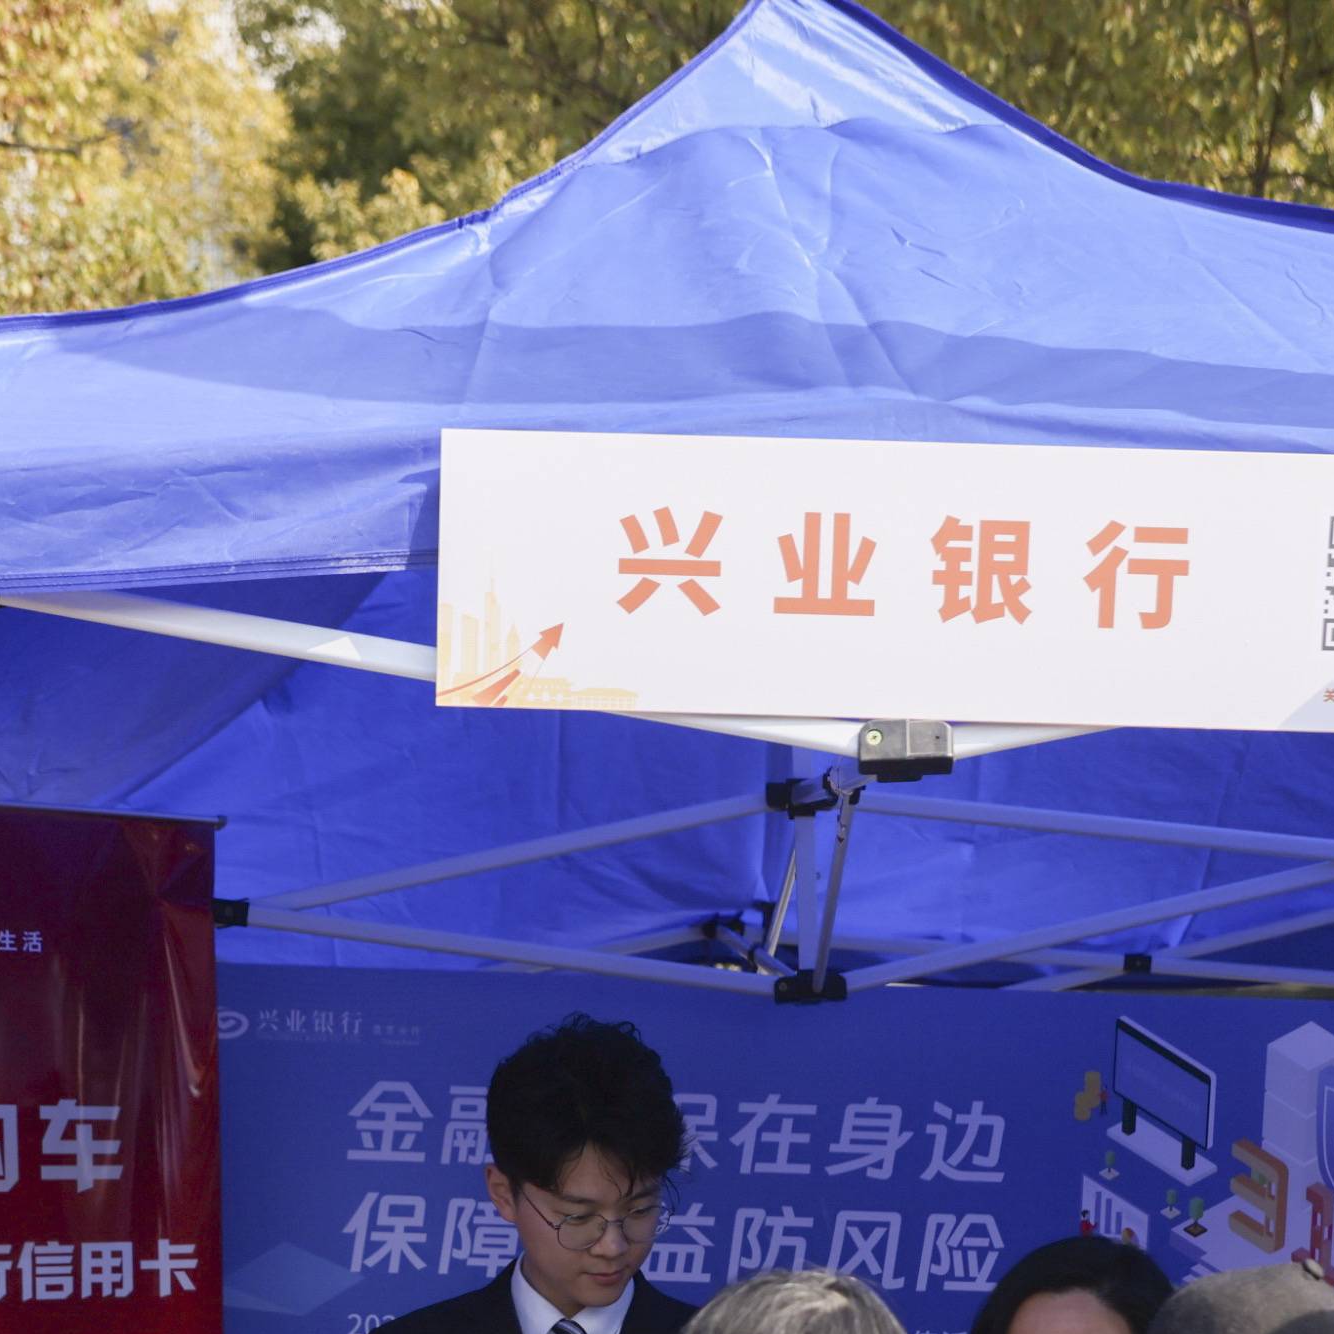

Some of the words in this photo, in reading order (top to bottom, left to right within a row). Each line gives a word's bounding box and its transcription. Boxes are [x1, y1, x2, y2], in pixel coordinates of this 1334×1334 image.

[617, 506, 1191, 631] 兴业银行
[259, 1009, 363, 1035] 兴业银行
